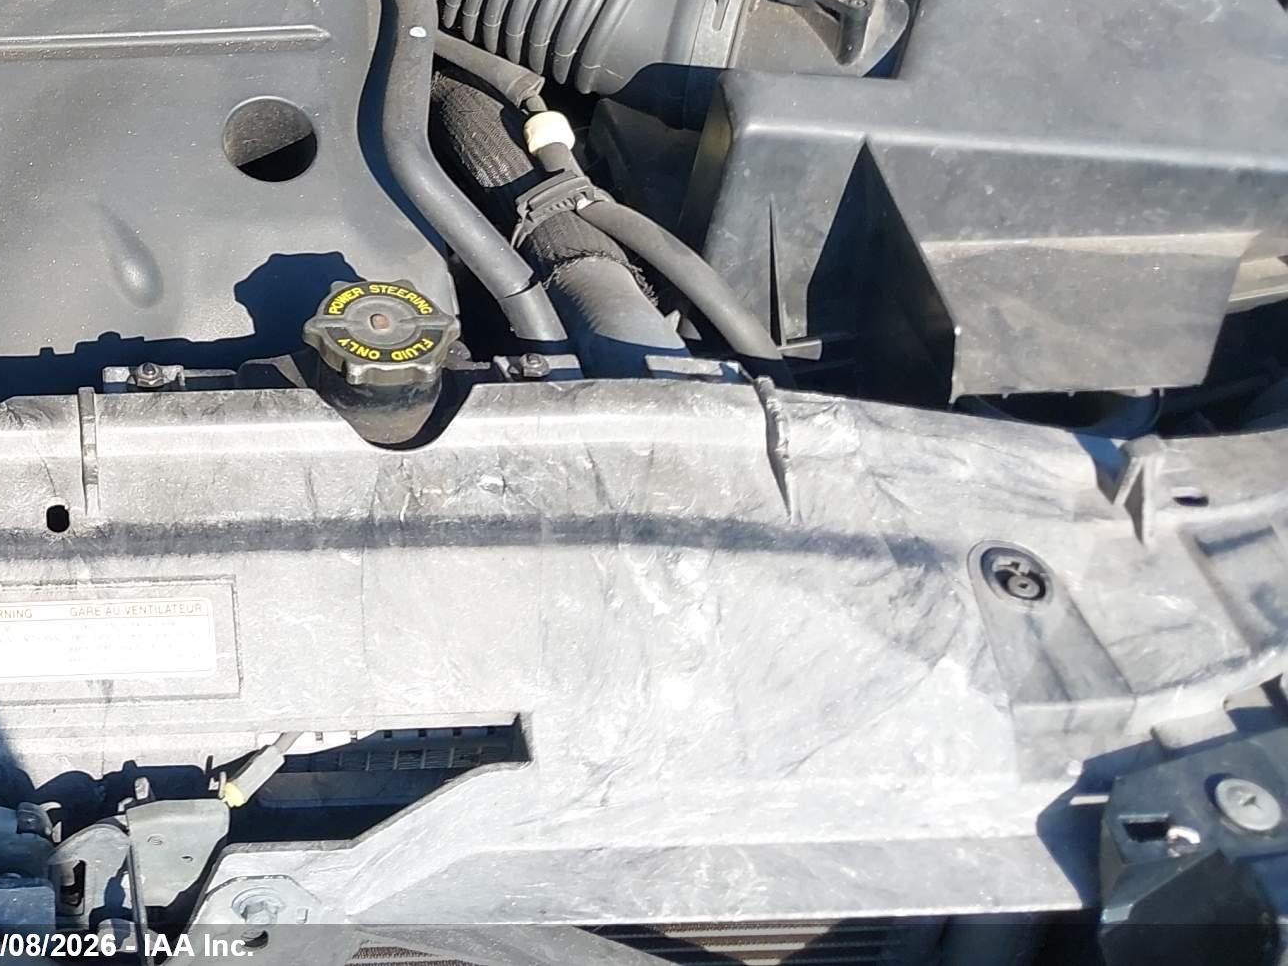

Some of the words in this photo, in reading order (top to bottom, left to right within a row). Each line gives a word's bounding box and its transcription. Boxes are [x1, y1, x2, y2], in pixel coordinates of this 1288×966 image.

[328, 286, 366, 315] POWER
[369, 284, 434, 315] STEERING
[337, 337, 381, 361] ONLY
[391, 338, 434, 362] FLUID
[70, 606, 102, 617] GARE
[125, 603, 201, 615] VENTILATEUR
